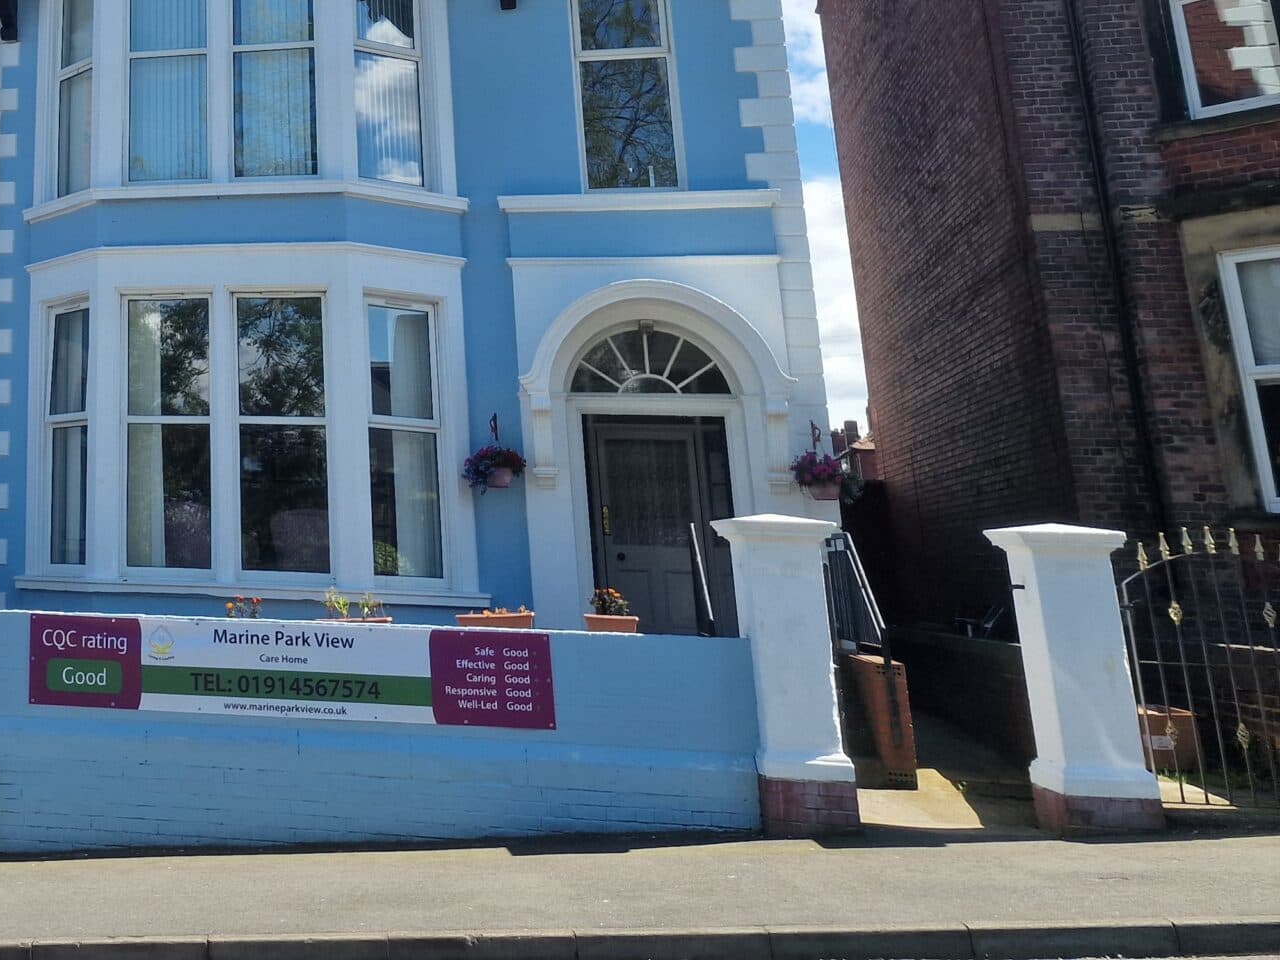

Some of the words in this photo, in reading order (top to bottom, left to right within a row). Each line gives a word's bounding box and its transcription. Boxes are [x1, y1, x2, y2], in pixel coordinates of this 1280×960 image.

[42, 629, 77, 650] CQC
[82, 634, 127, 654] rating
[213, 629, 270, 646] Marine
[275, 631, 311, 647] Park
[316, 633, 354, 649] View
[475, 647, 495, 656] Safe
[503, 647, 529, 657] Good
[259, 654, 278, 664] Care
[282, 655, 308, 665] Home
[456, 659, 496, 670] Effective
[504, 661, 530, 671] Good
[62, 666, 107, 686] Good
[466, 673, 496, 685] Caring
[504, 674, 530, 684] Good
[190, 672, 232, 692] TEL:
[237, 675, 381, 699] 01914567574
[445, 685, 497, 699] Responsive
[505, 688, 531, 698] Good
[224, 702, 347, 715] www.marineparkview.co.uk
[458, 700, 498, 710] Well-Led
[506, 702, 532, 712] Good
